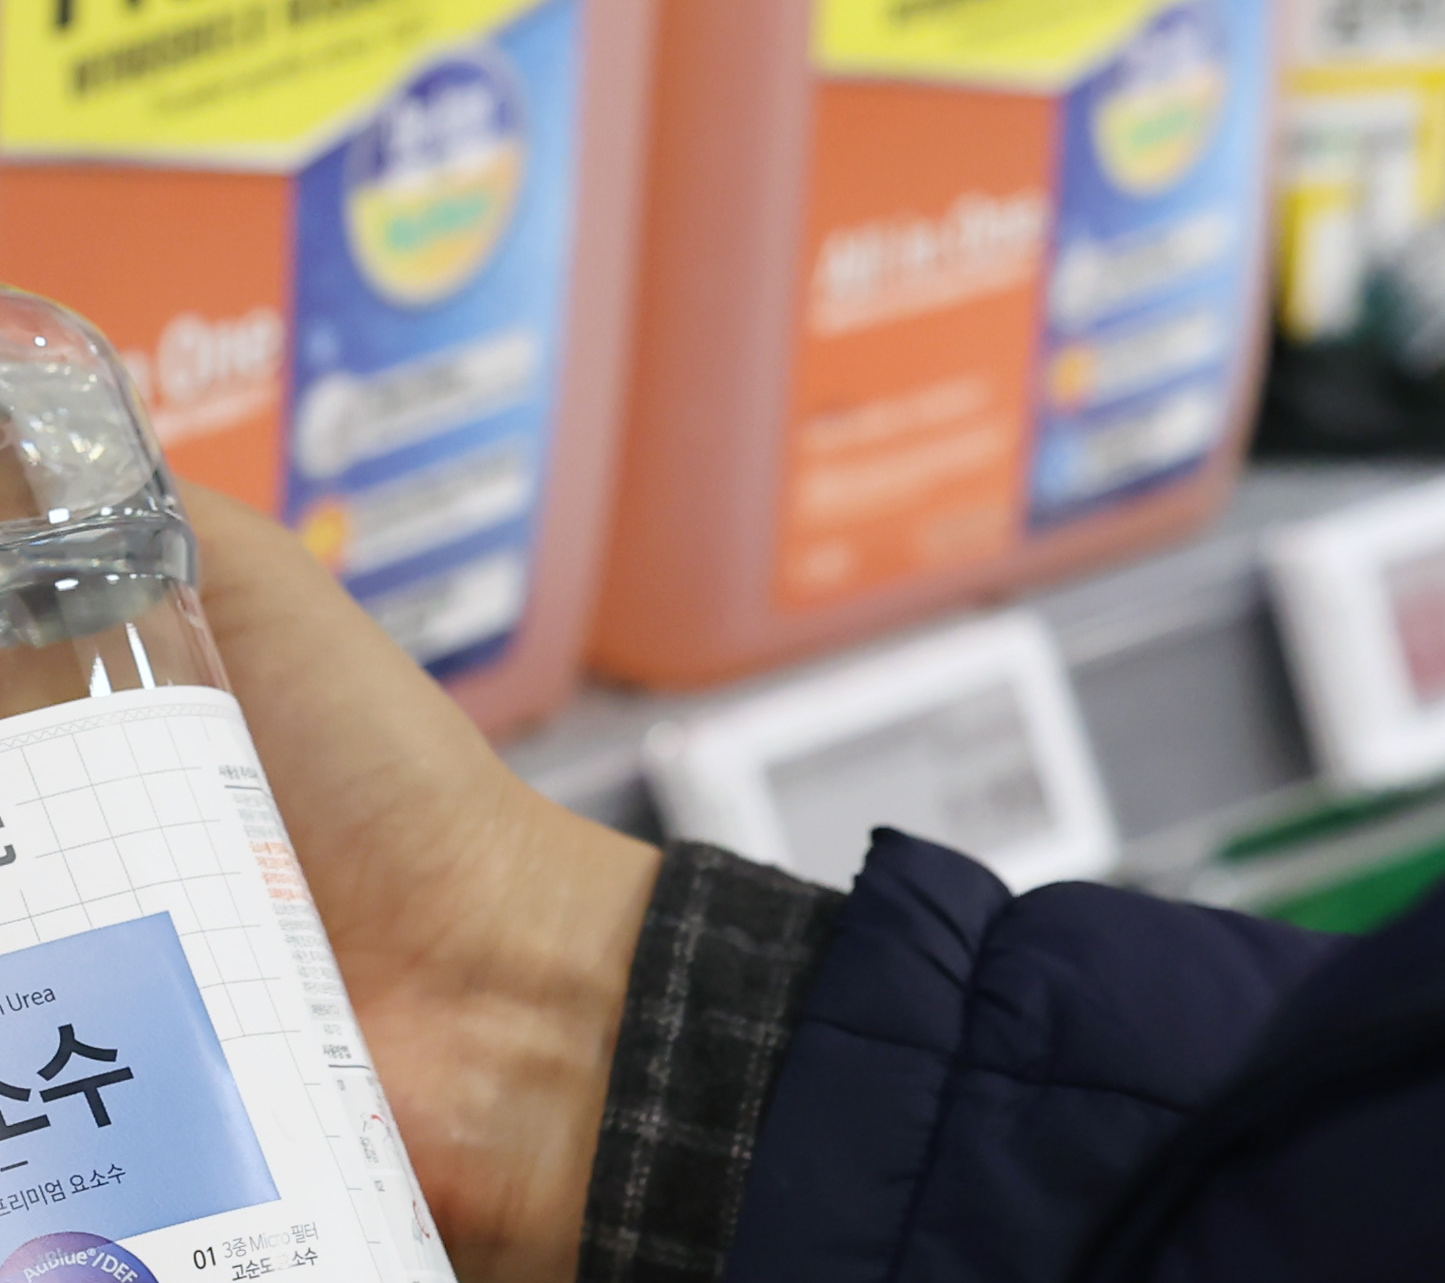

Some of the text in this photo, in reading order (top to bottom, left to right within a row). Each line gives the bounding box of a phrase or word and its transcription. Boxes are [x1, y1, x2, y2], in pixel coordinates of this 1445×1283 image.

[5, 987, 57, 1014] Urea
[68, 1163, 127, 1196] 요소수
[222, 1237, 248, 1260] 3중
[290, 1222, 319, 1244] 필터
[193, 1246, 217, 1271] 01
[231, 1256, 275, 1282] 고순도
